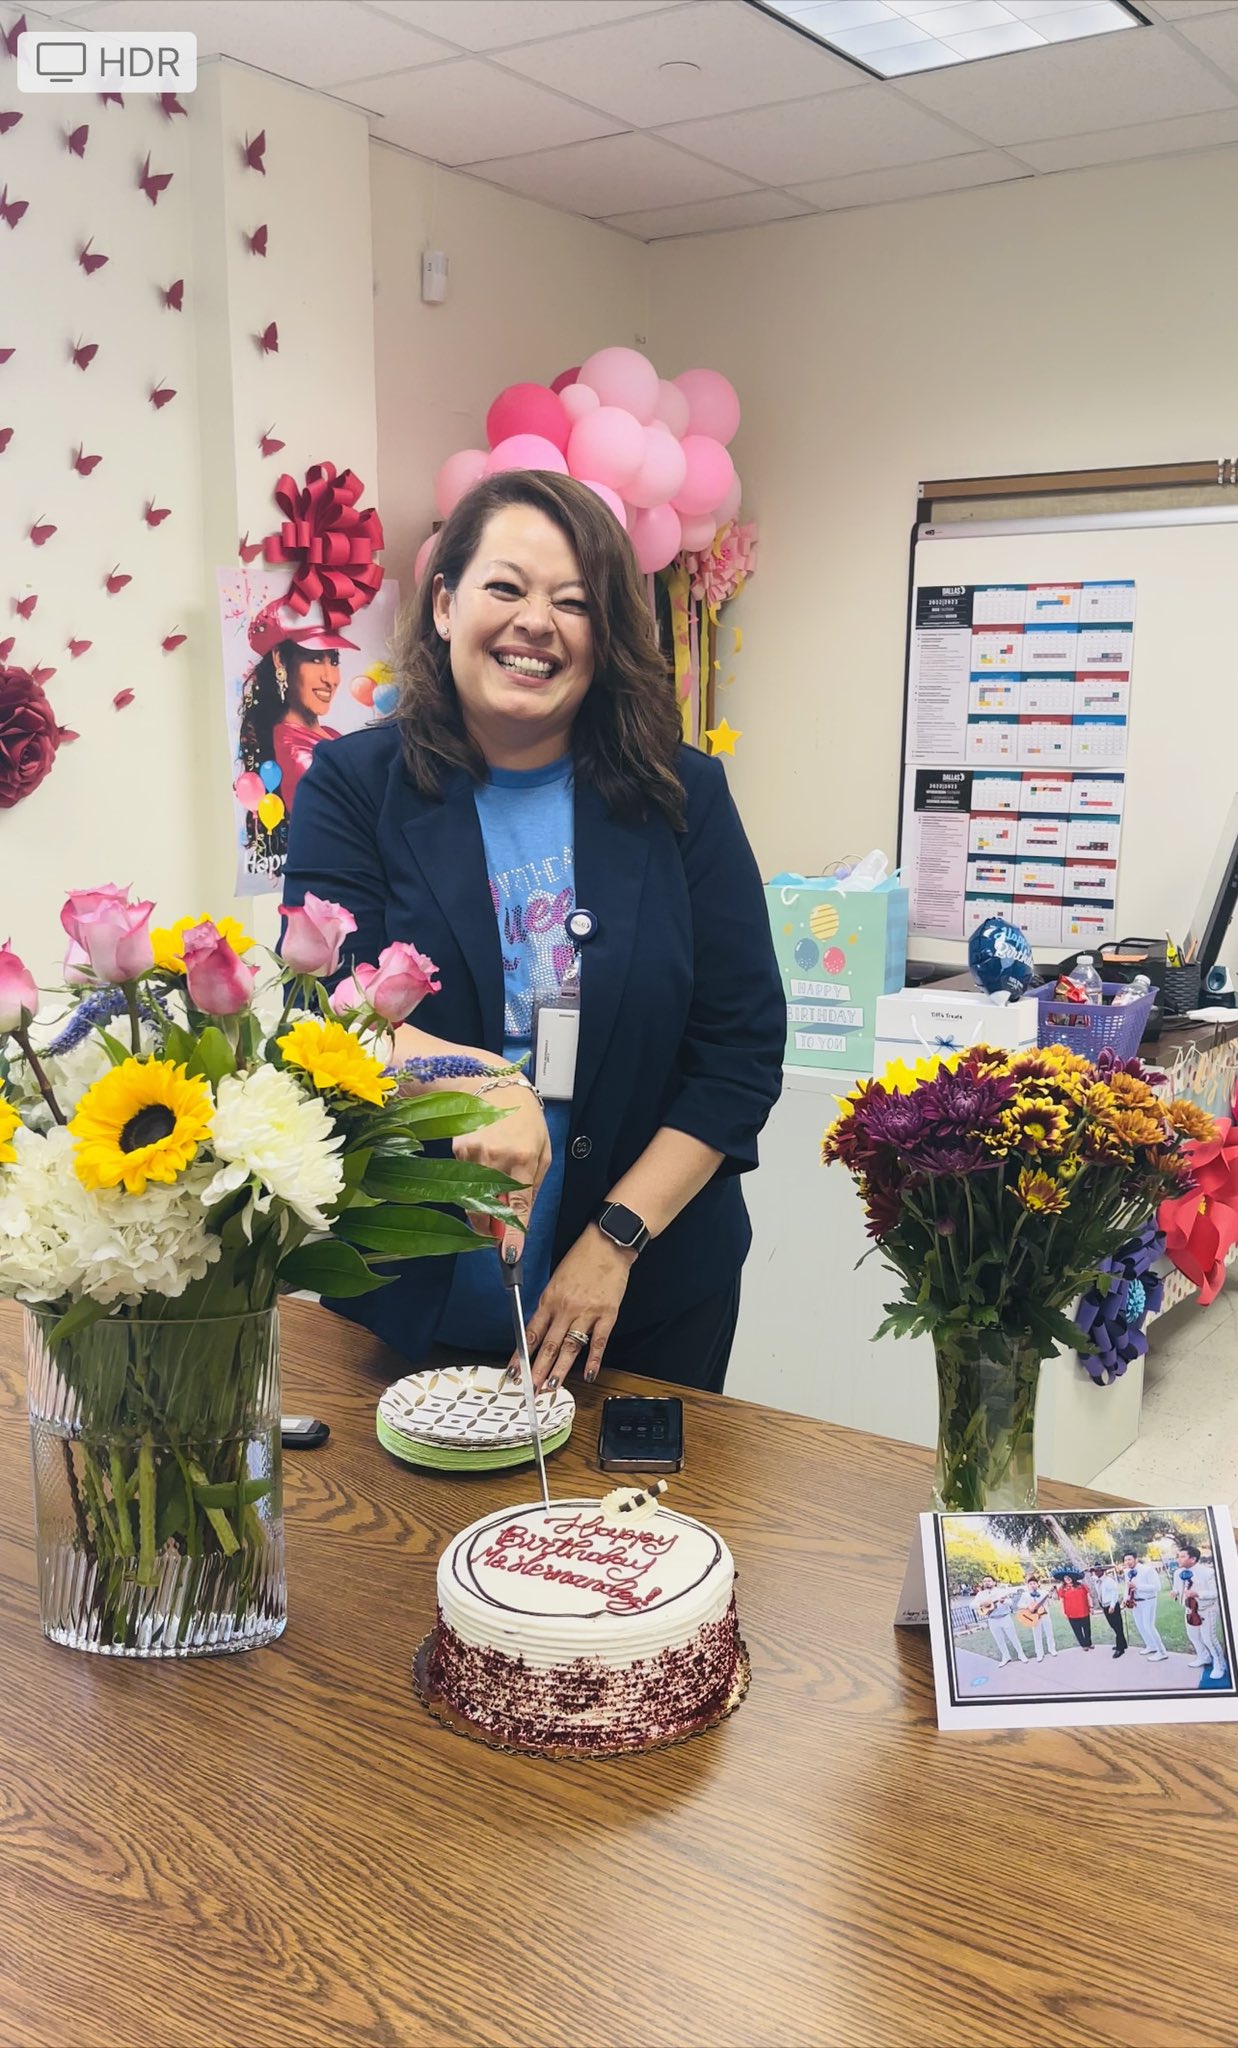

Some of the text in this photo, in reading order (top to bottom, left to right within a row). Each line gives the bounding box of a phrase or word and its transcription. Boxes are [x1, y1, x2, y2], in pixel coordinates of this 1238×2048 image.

[244, 851, 287, 879] Hap
[798, 982, 842, 998] HAPPY
[787, 1006, 856, 1023] BIRTHDAY
[800, 1035, 844, 1050] TO YOU
[544, 1513, 679, 1555] Happy
[470, 1546, 507, 1571] Ms.
[495, 1525, 657, 1581] Birthday
